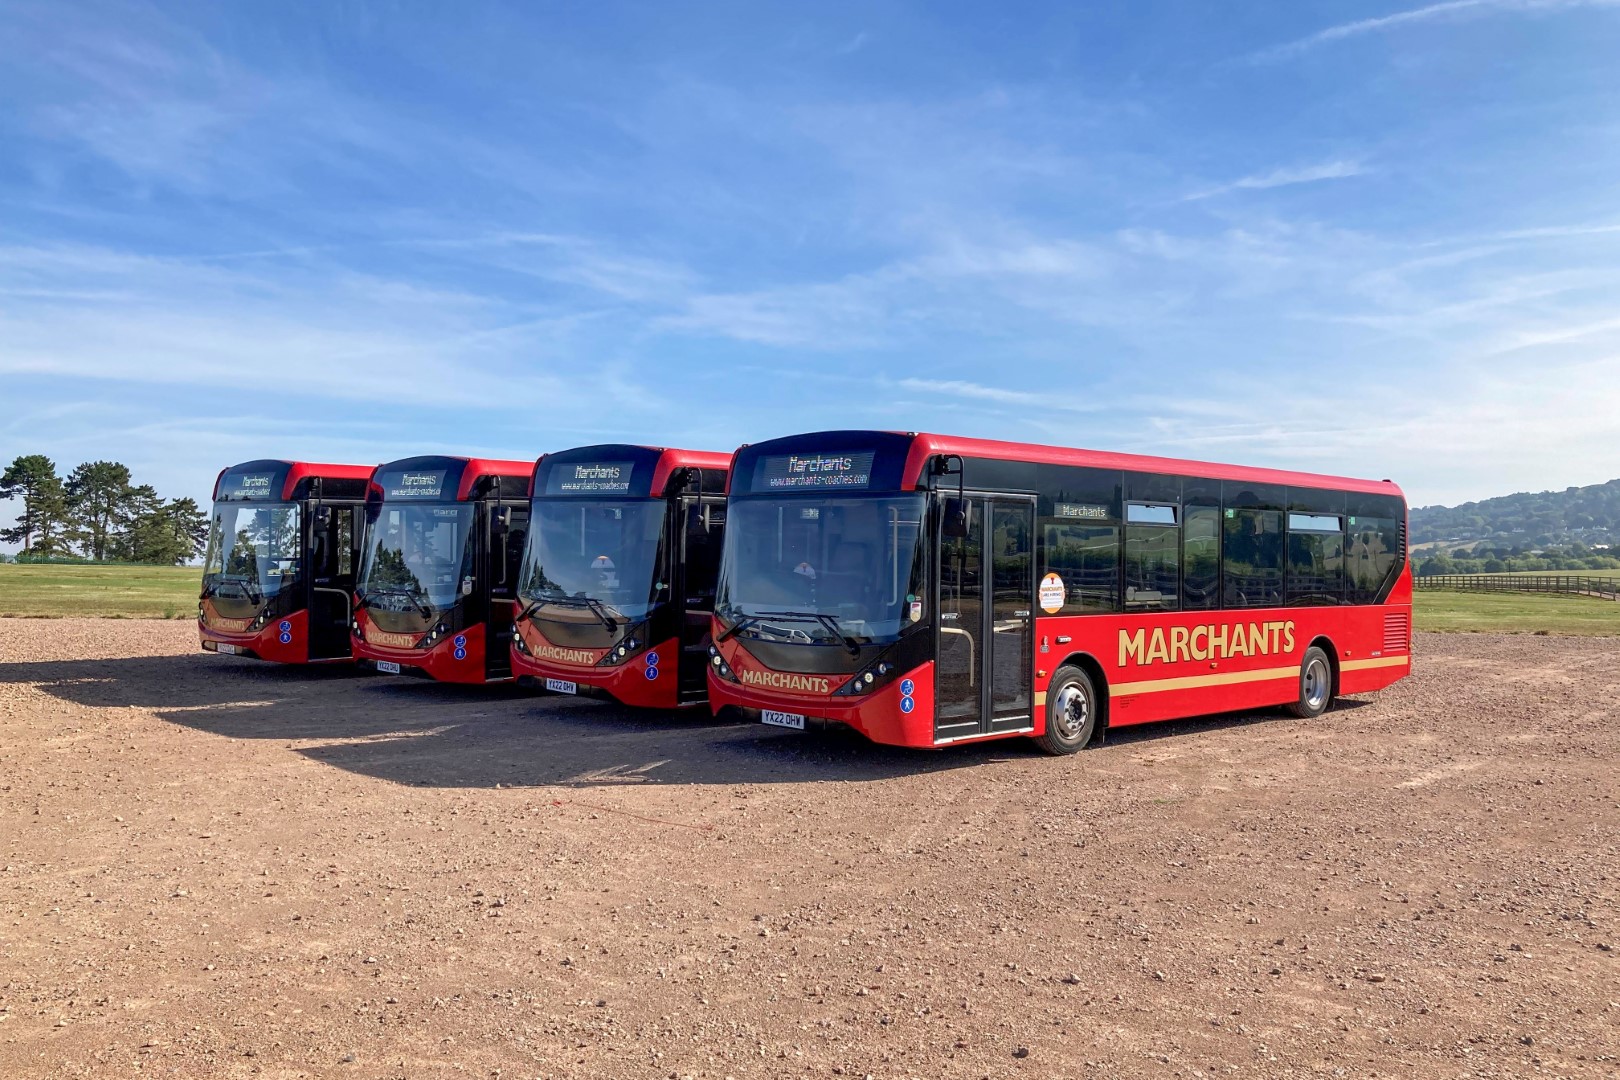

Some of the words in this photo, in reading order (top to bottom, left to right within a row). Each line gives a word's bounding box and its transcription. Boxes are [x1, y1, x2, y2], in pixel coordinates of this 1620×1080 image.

[574, 464, 620, 479] Marchants
[788, 455, 852, 473] Marchants
[242, 476, 269, 487] Marchants
[402, 473, 437, 486] Marchants
[770, 471, 868, 487] www.marchants-coaches.com
[1063, 504, 1106, 518] Marchants
[210, 617, 246, 631] MARCHANTS
[368, 632, 413, 647] MARCHANTS
[1117, 619, 1296, 668] MARCHANTS
[533, 644, 594, 665] MARCHANTS
[742, 669, 829, 693] MARCHANTS
[765, 711, 785, 724] YX22
